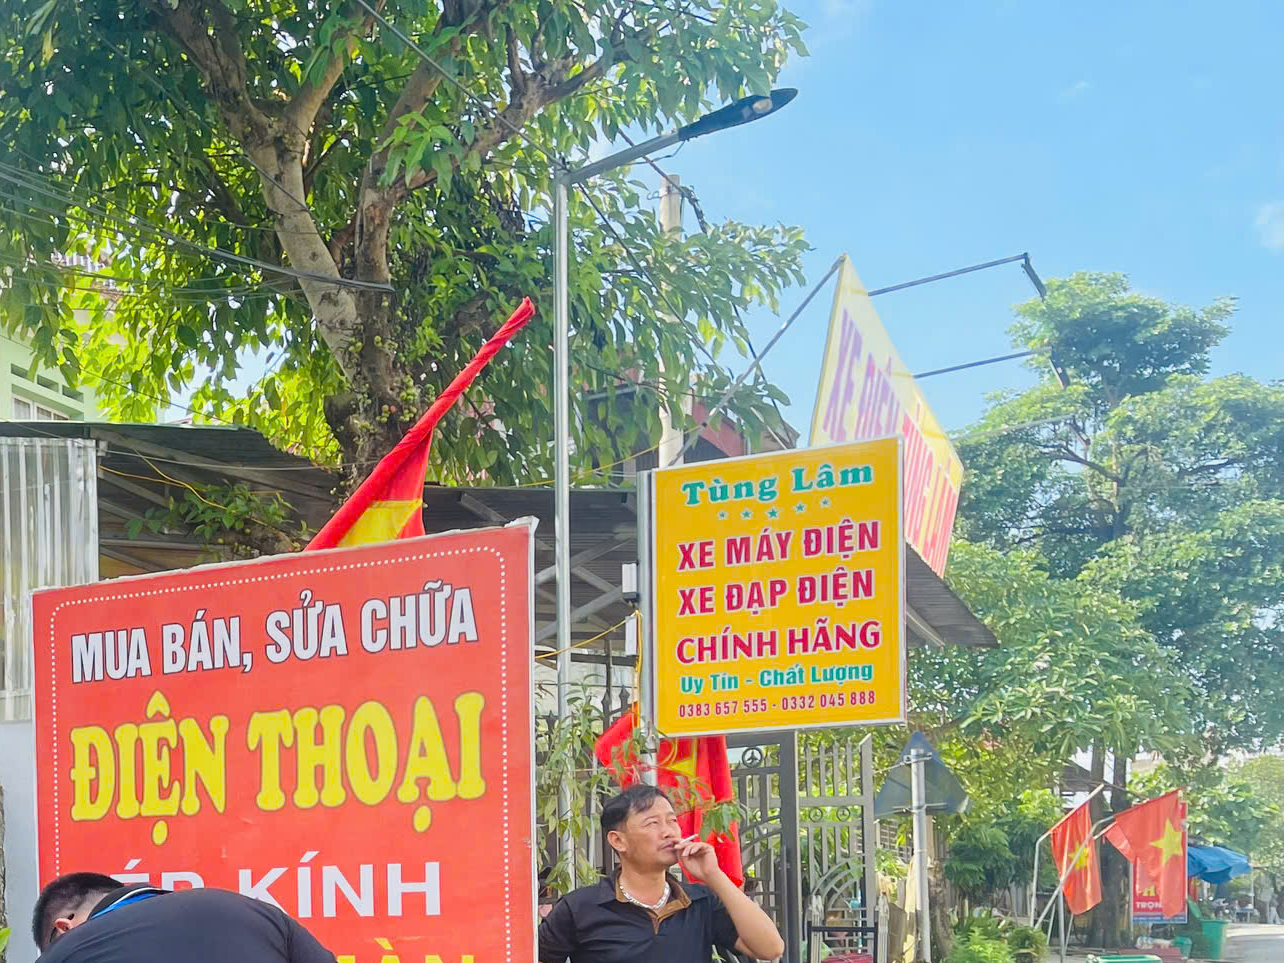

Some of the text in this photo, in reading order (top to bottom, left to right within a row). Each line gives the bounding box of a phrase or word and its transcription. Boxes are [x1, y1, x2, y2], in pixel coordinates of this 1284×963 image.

[682, 464, 873, 506] Tùng Lâm
[678, 519, 879, 570] XE MÁY ĐIỆN
[678, 567, 873, 616] XE ĐẠP ĐIỆN
[71, 580, 478, 684] MUA BÁN, SỬA CHỮA
[676, 618, 881, 664] CHÍNH HÃNG
[681, 676, 703, 694] Uy
[710, 672, 738, 691] Tín
[759, 664, 804, 686] Chất
[811, 664, 873, 685] Lượng
[679, 703, 710, 718] 0383
[716, 701, 738, 716] 657
[744, 699, 767, 713] 555
[782, 695, 815, 710] 0332
[820, 692, 845, 708] 045
[850, 690, 875, 705] 888
[69, 690, 486, 846] ĐIỆN THOẠI
[238, 851, 441, 918] KÍNH
